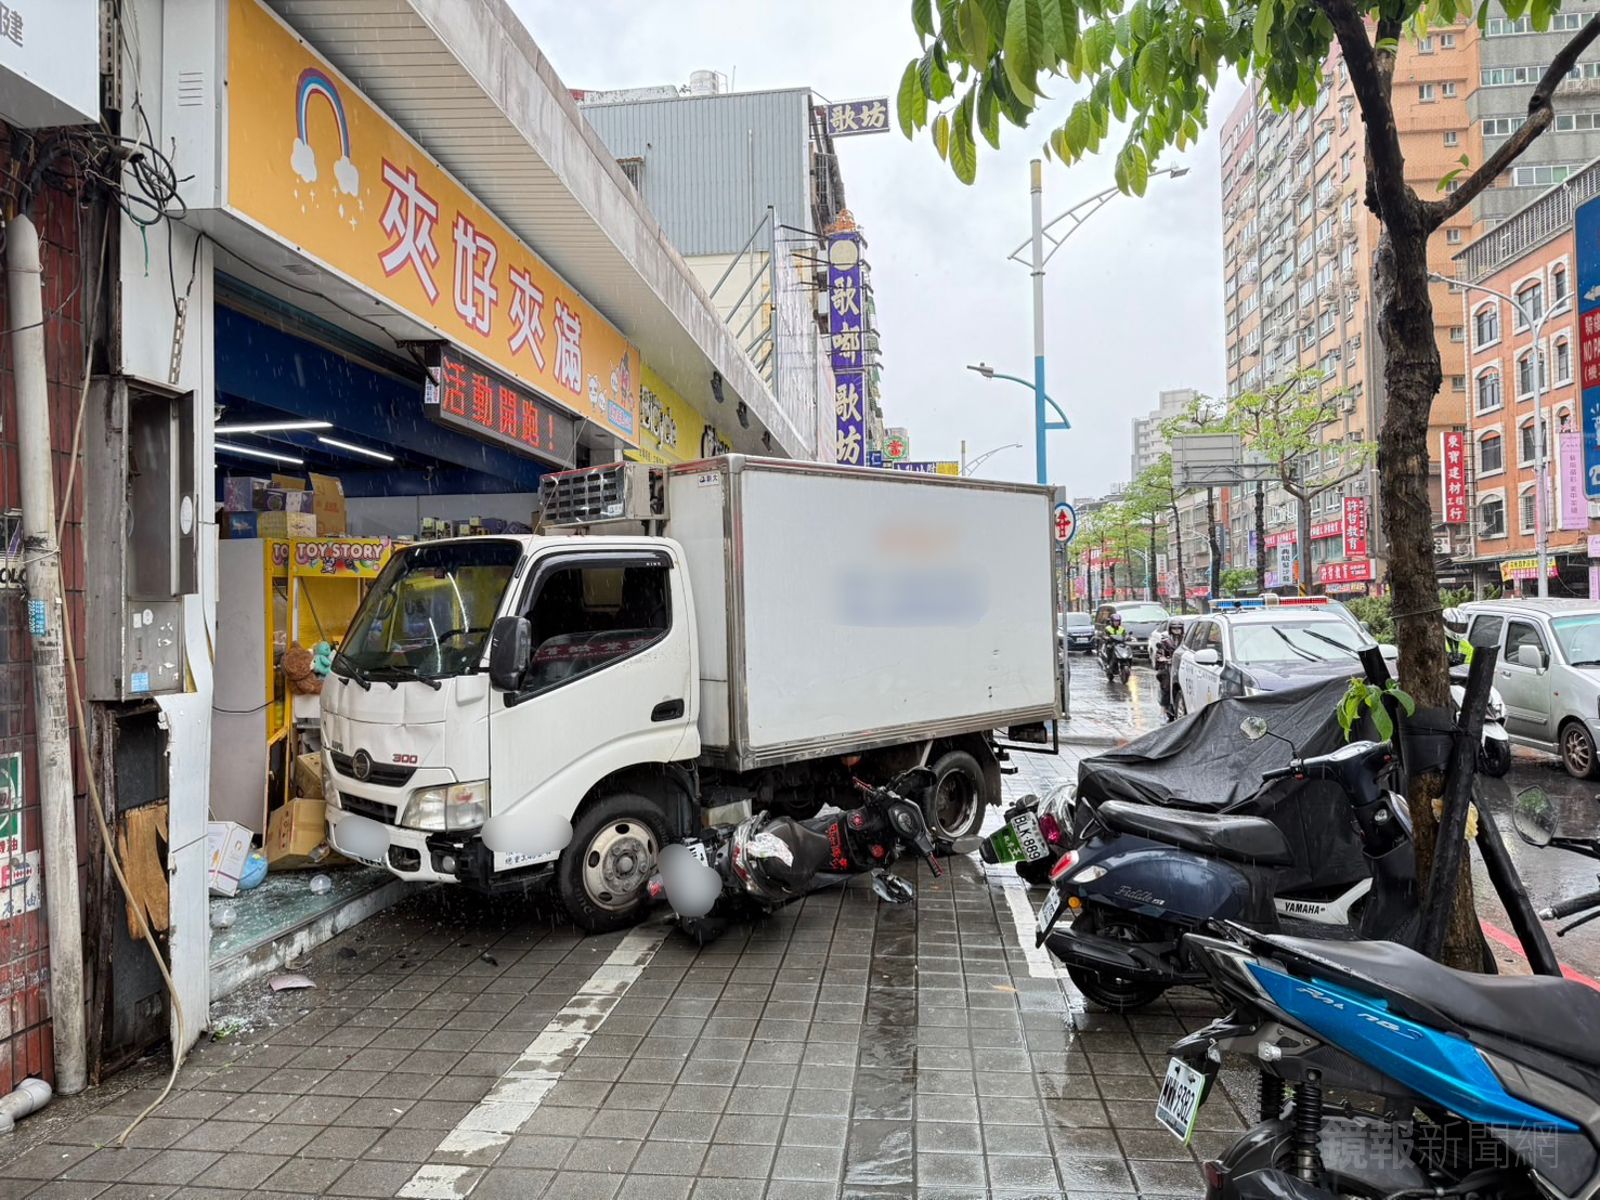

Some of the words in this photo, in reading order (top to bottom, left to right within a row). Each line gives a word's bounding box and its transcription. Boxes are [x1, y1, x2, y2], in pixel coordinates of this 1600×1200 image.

[830, 102, 887, 132] 歌坊
[378, 157, 582, 396] 夾好夾滿
[297, 543, 328, 558] TOY
[333, 543, 383, 561] STORY
[392, 753, 418, 764] 300
[1285, 901, 1320, 915] YAMAHA
